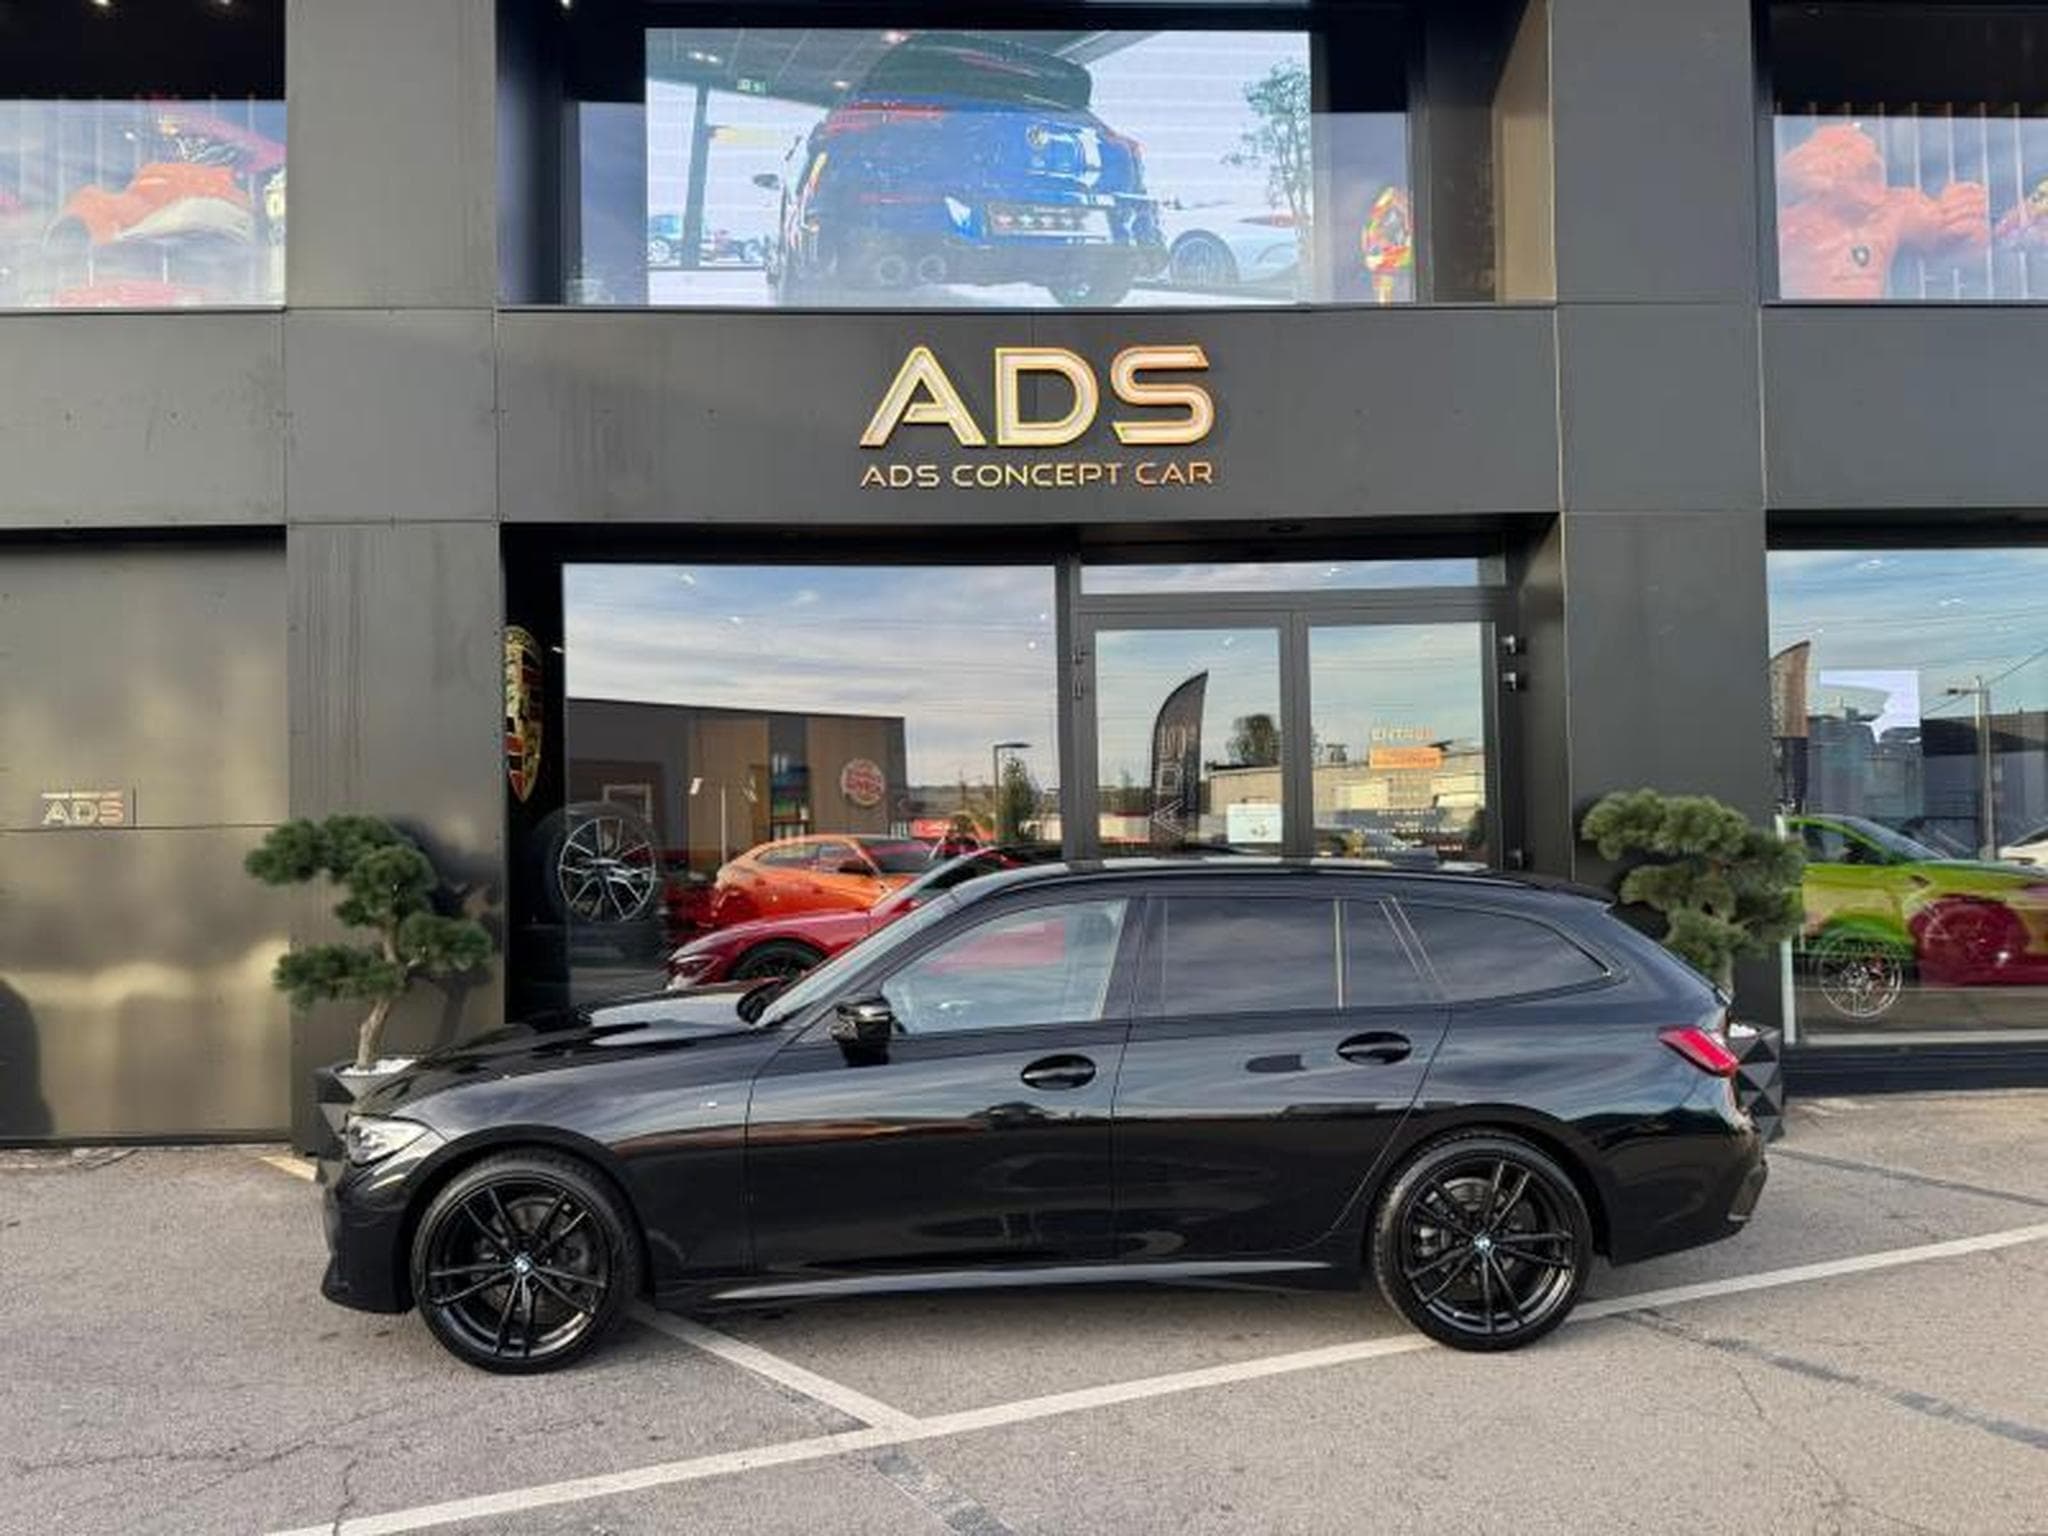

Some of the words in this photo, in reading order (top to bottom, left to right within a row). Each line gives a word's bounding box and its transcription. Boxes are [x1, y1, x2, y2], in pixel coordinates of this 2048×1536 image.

[859, 344, 1214, 447] ADS
[860, 465, 940, 488] ADS
[951, 463, 1122, 488] CONCEPT
[1135, 462, 1214, 486] CAR
[40, 792, 124, 825] ADS
